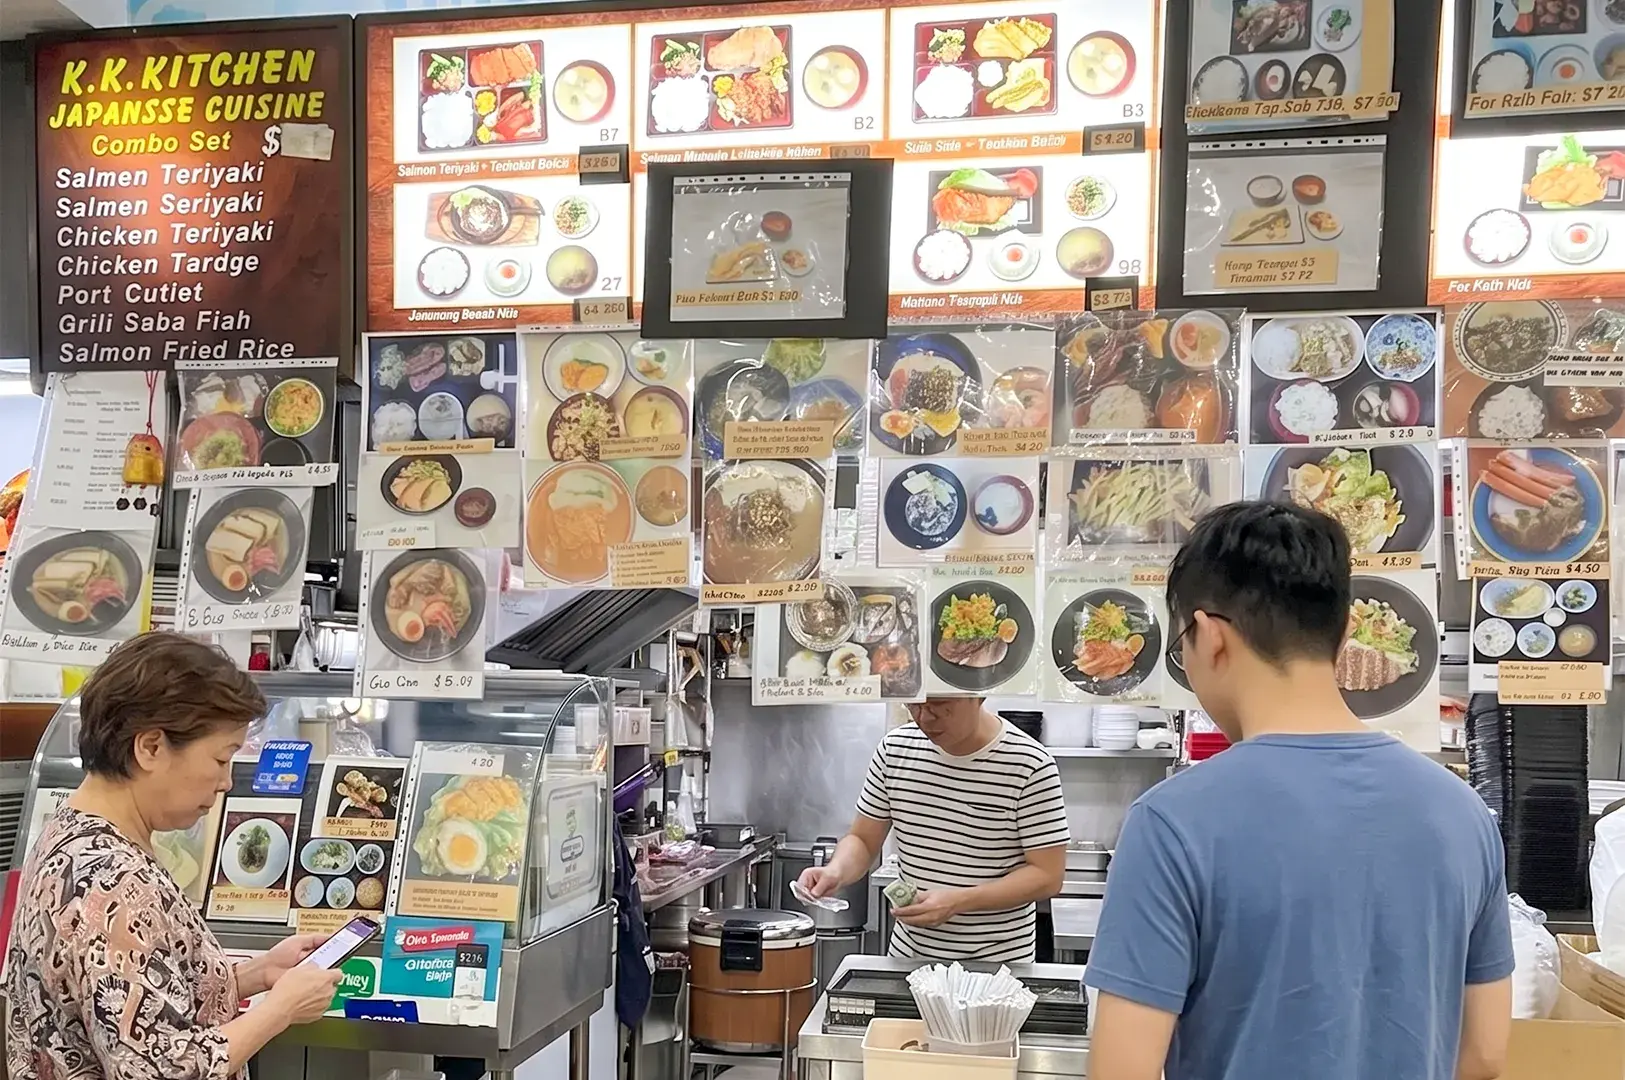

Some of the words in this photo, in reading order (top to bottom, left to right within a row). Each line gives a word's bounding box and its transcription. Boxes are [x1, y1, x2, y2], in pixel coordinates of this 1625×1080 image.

[49, 96, 194, 129] JAPANSSE
[205, 91, 325, 123] CUISINE
[1123, 103, 1144, 118] B3
[1469, 96, 1497, 111] For
[600, 128, 619, 141] B7
[854, 116, 874, 130] B2
[92, 132, 180, 156] Combo
[189, 130, 232, 152] Set
[261, 124, 283, 157] $
[55, 166, 148, 189] Salmen
[161, 161, 265, 189] Teriyaki
[55, 196, 148, 219] Salmen
[159, 191, 264, 219] Seriyaki
[57, 224, 158, 248] Chicken
[170, 220, 275, 248] Teriyaki
[57, 252, 158, 277] Chicken
[170, 251, 260, 278] Tardge
[1118, 259, 1142, 275] 98
[58, 285, 112, 305] Port
[601, 277, 622, 291] 27
[58, 312, 113, 335] Grili
[123, 311, 185, 333] Saba
[196, 309, 251, 331] Fiah
[58, 341, 151, 364] Salmon
[163, 340, 228, 360] Fried
[238, 339, 295, 359] Rice
